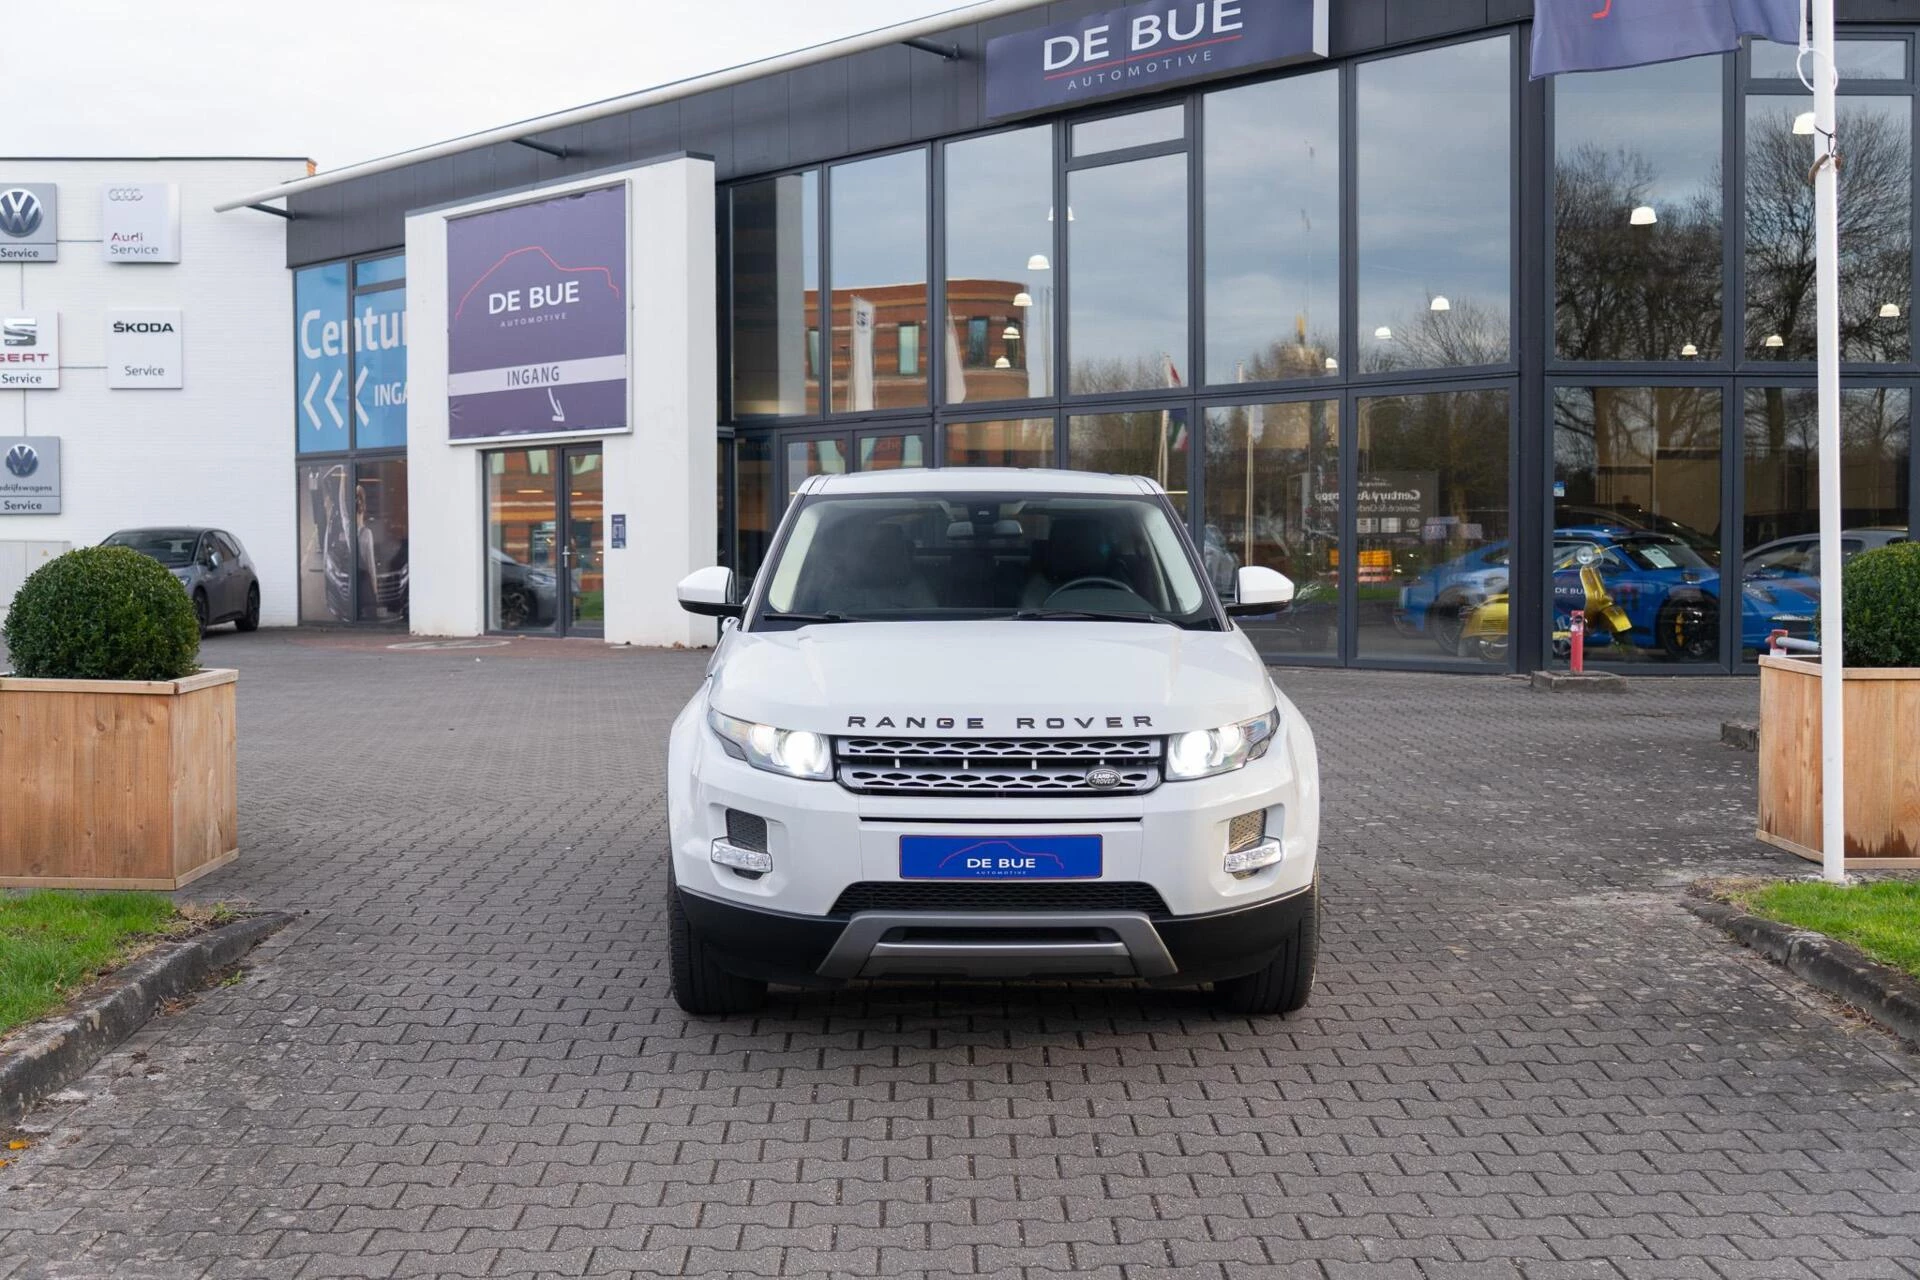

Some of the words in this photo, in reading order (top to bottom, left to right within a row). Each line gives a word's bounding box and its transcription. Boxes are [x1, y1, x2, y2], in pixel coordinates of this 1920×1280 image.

[1043, 25, 1110, 71] DE
[1131, 0, 1244, 51] BUE
[1067, 50, 1213, 91] AUTOMOTIVE
[111, 232, 143, 242] Audi
[0, 247, 39, 258] Service
[110, 244, 159, 255] Service
[489, 290, 521, 315] DE
[529, 280, 580, 309] BUE
[500, 312, 567, 328] AUTOMOTIVE
[113, 321, 174, 333] ŠKODA
[124, 366, 165, 376] Service
[507, 365, 560, 387] INGANG
[1, 373, 42, 384] Service
[0, 483, 52, 493] drijfswagens
[4, 500, 42, 510] Service
[848, 716, 984, 729] RANGE
[1017, 716, 1153, 729] ROVER
[967, 858, 992, 868] DE
[999, 858, 1036, 868] BUE
